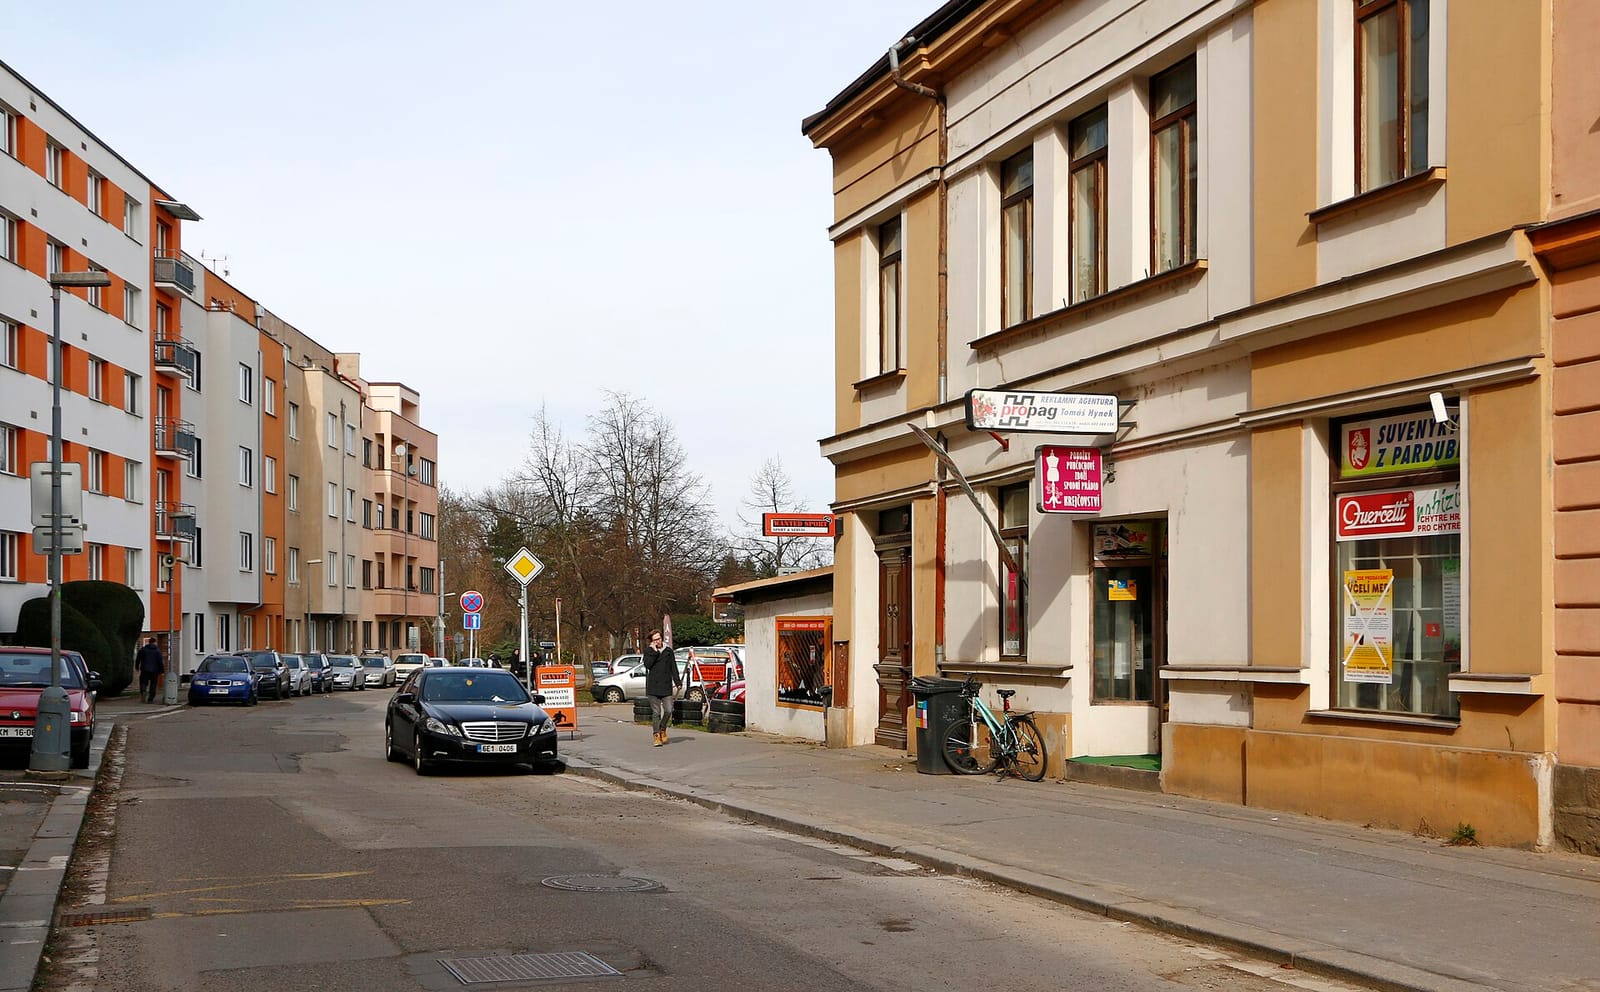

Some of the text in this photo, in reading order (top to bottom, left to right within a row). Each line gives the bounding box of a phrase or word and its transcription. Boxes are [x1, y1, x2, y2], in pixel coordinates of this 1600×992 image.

[1078, 397, 1114, 405] AGENTURA
[1001, 405, 1058, 420] propag
[1060, 408, 1114, 419] Tomáš Hynek
[1376, 439, 1460, 467] Z PARDUB
[1063, 494, 1100, 507] KREJČOVSTVÍ
[1343, 498, 1410, 529] Quercetti
[1417, 524, 1431, 532] PRO
